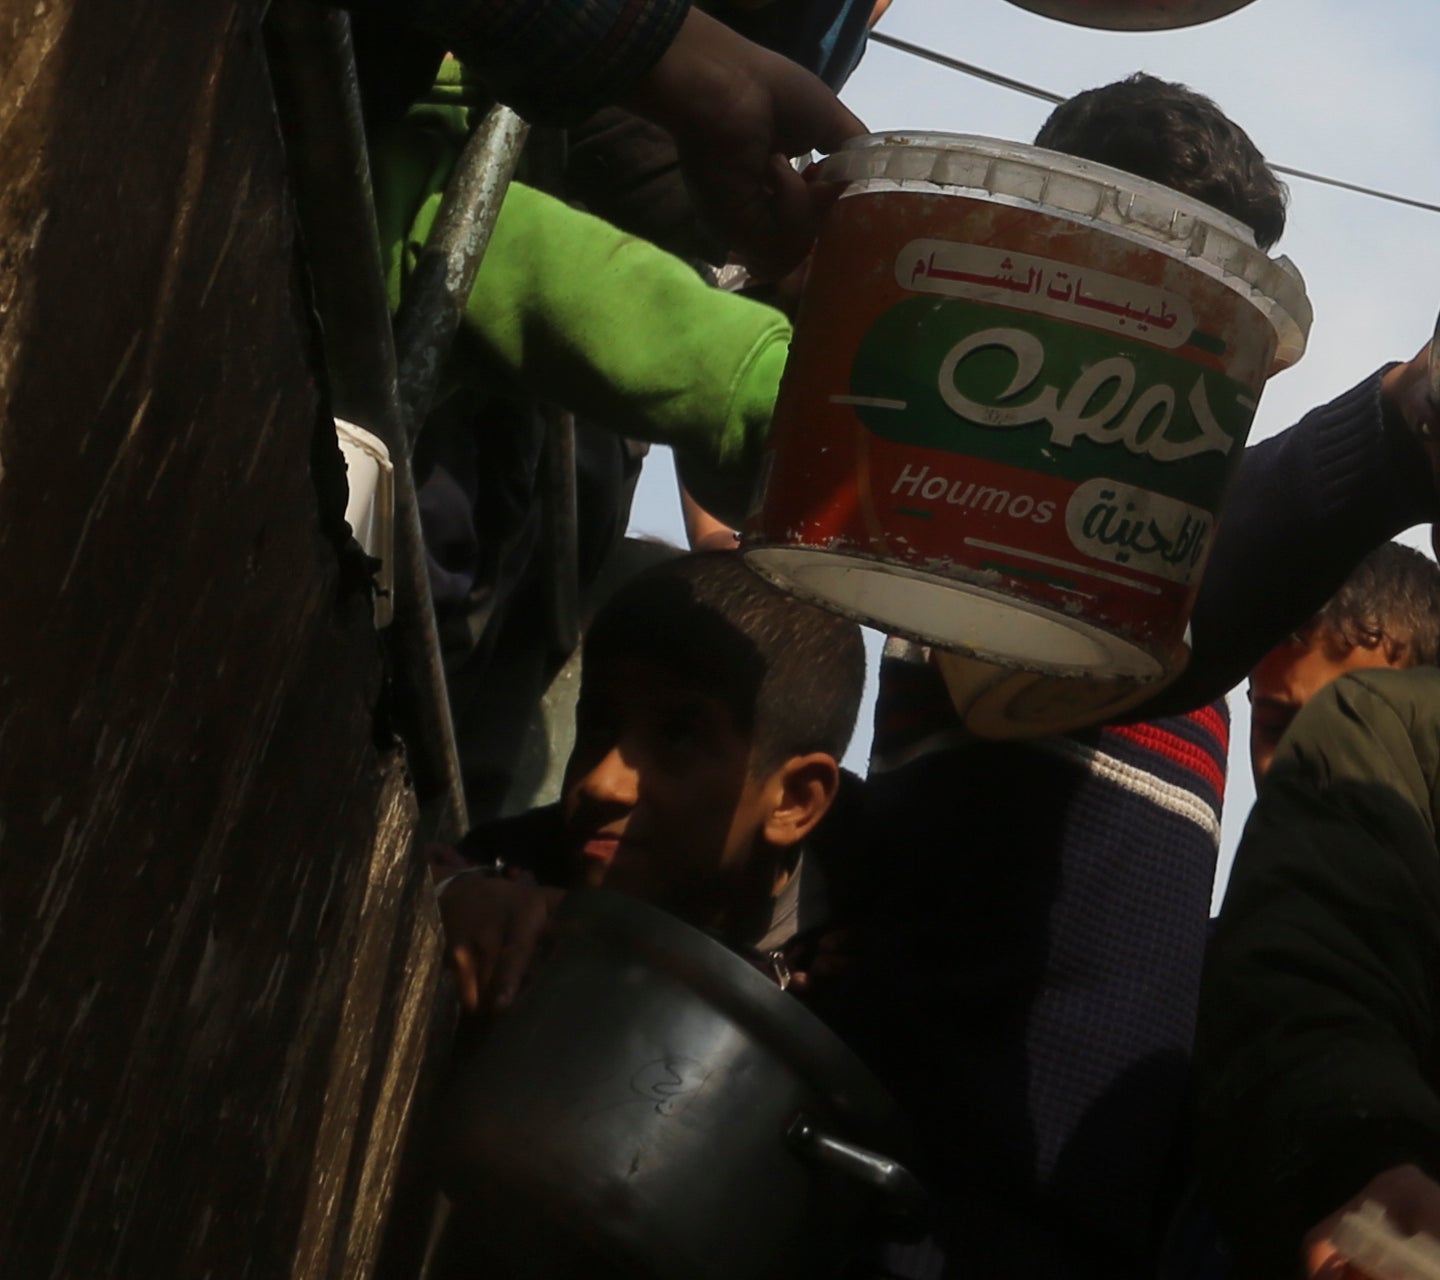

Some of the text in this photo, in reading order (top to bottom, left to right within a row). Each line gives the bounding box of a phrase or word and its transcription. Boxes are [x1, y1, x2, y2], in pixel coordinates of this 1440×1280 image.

[911, 251, 1178, 332] طيبات الشام
[937, 327, 1235, 462] حمص
[891, 463, 1058, 525] Houmos
[1081, 490, 1208, 582] بالطحينة
